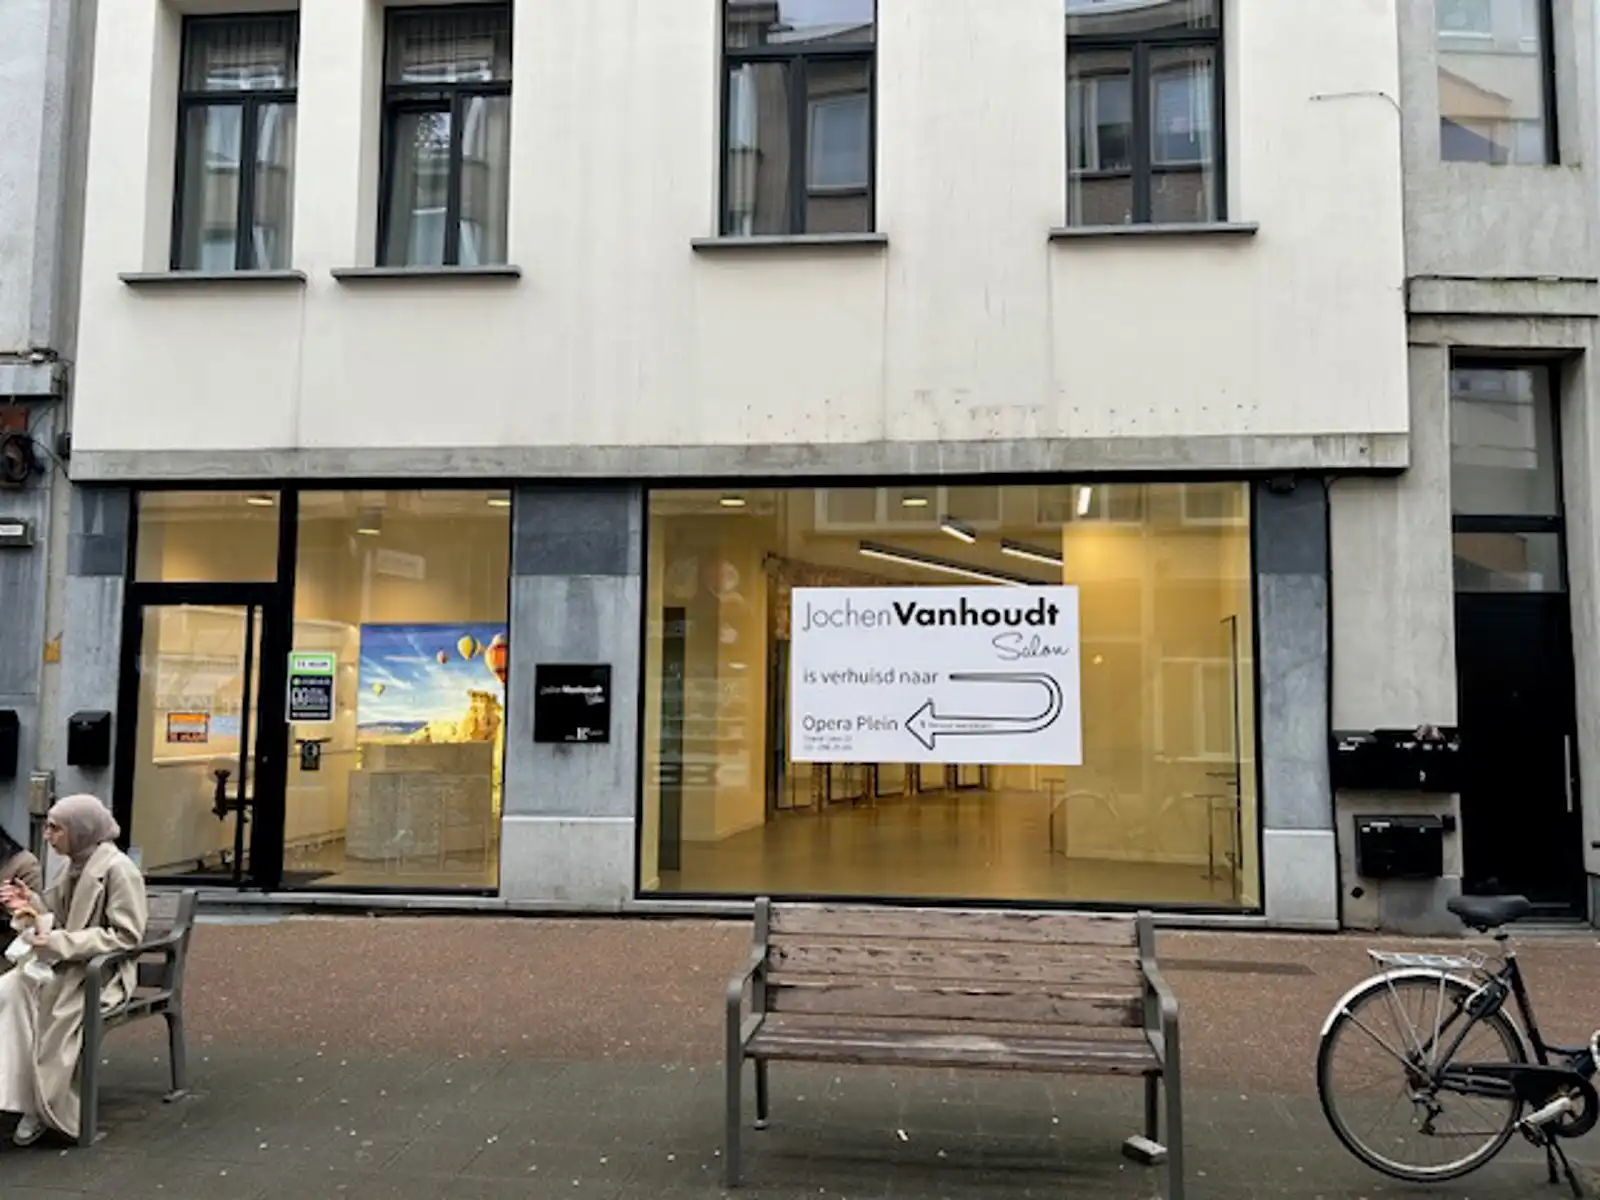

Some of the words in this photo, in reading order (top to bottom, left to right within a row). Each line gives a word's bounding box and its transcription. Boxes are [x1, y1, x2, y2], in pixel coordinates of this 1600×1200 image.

[992, 632, 1069, 661] Salon
[803, 669, 816, 685] is
[820, 668, 895, 686] verhuisd
[899, 672, 938, 686] naar
[802, 715, 851, 733] Opera
[857, 714, 899, 731] Plein
